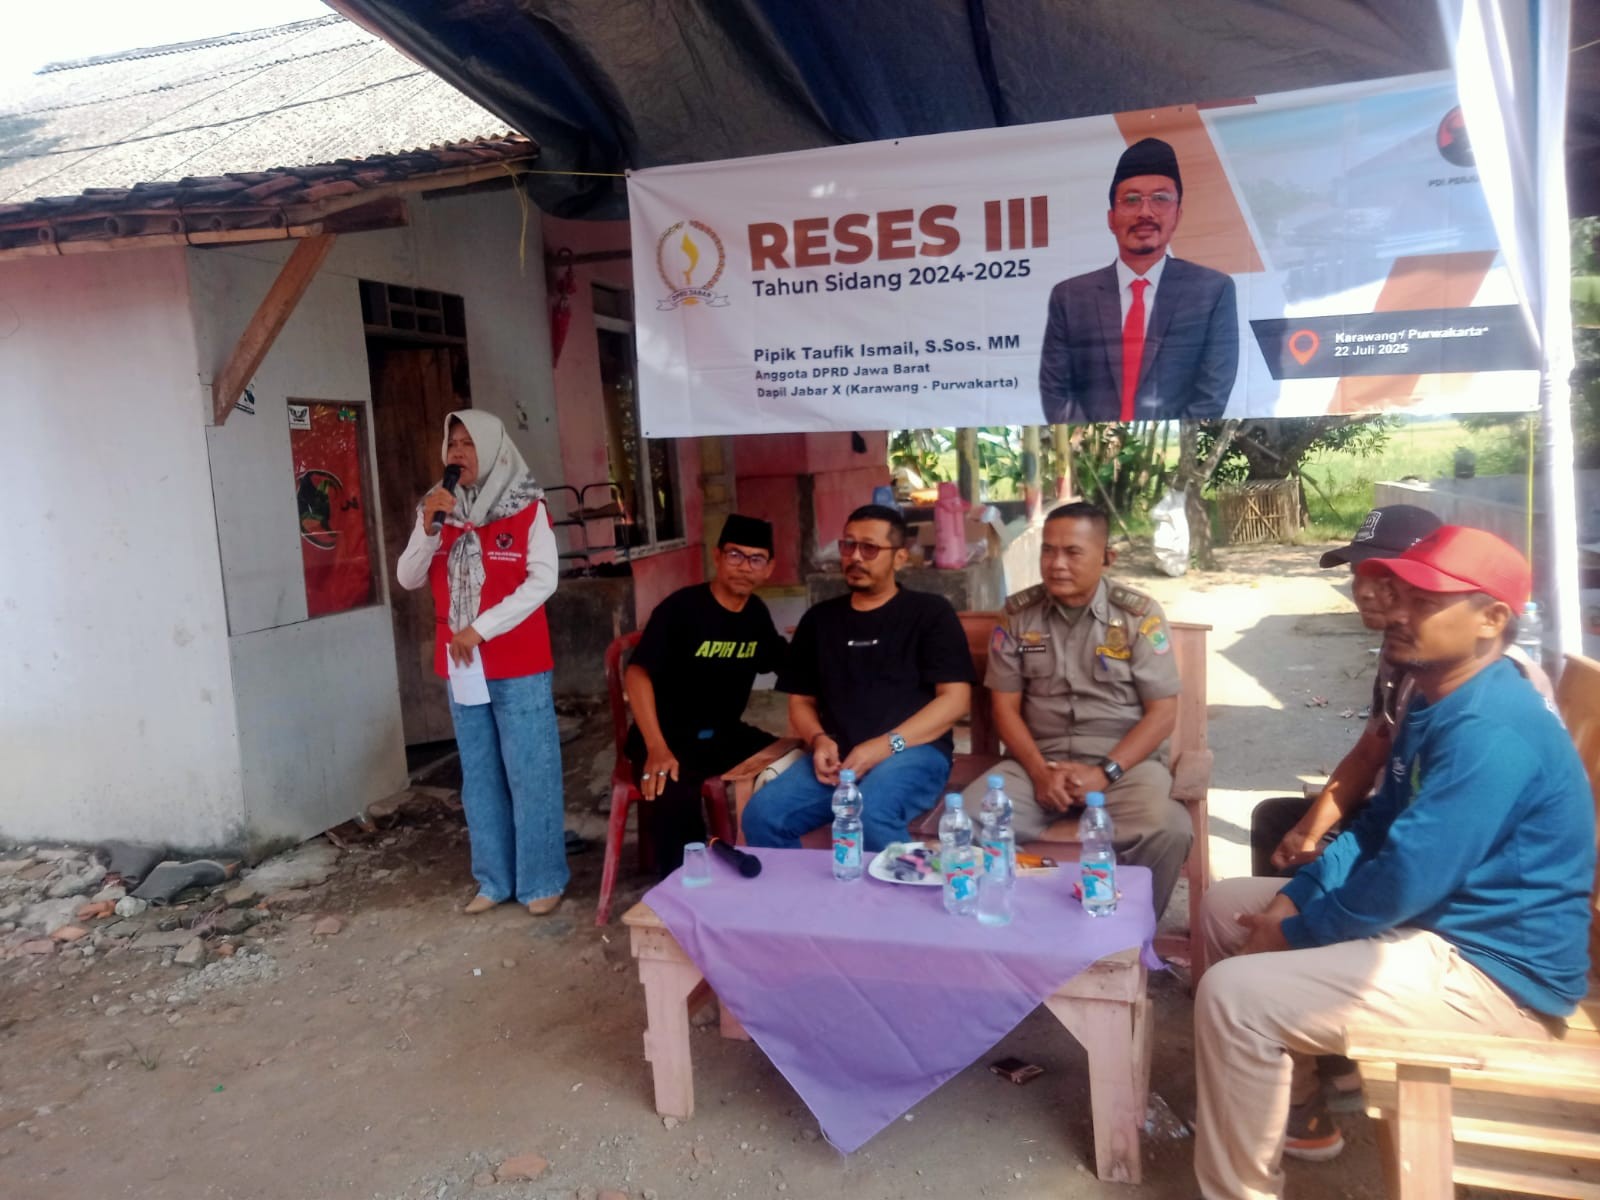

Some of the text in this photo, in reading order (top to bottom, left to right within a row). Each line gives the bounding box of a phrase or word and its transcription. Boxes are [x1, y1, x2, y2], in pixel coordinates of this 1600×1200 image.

[748, 195, 1048, 271] RESES III
[752, 259, 1031, 297] Tahun Sidang 2024-2025
[754, 335, 1020, 365] Pipik Taufik Ismail, S.Sos. MM
[1334, 342, 1409, 357] 22 Juli 2025
[755, 362, 931, 382] Anggota DPRD Jawa Barat
[757, 386, 787, 399] Dapil
[790, 385, 828, 397] Jabar
[832, 384, 841, 396] X
[846, 381, 919, 398] (Karawang
[932, 376, 1019, 392] Purwakarta)
[695, 640, 737, 658] APIH
